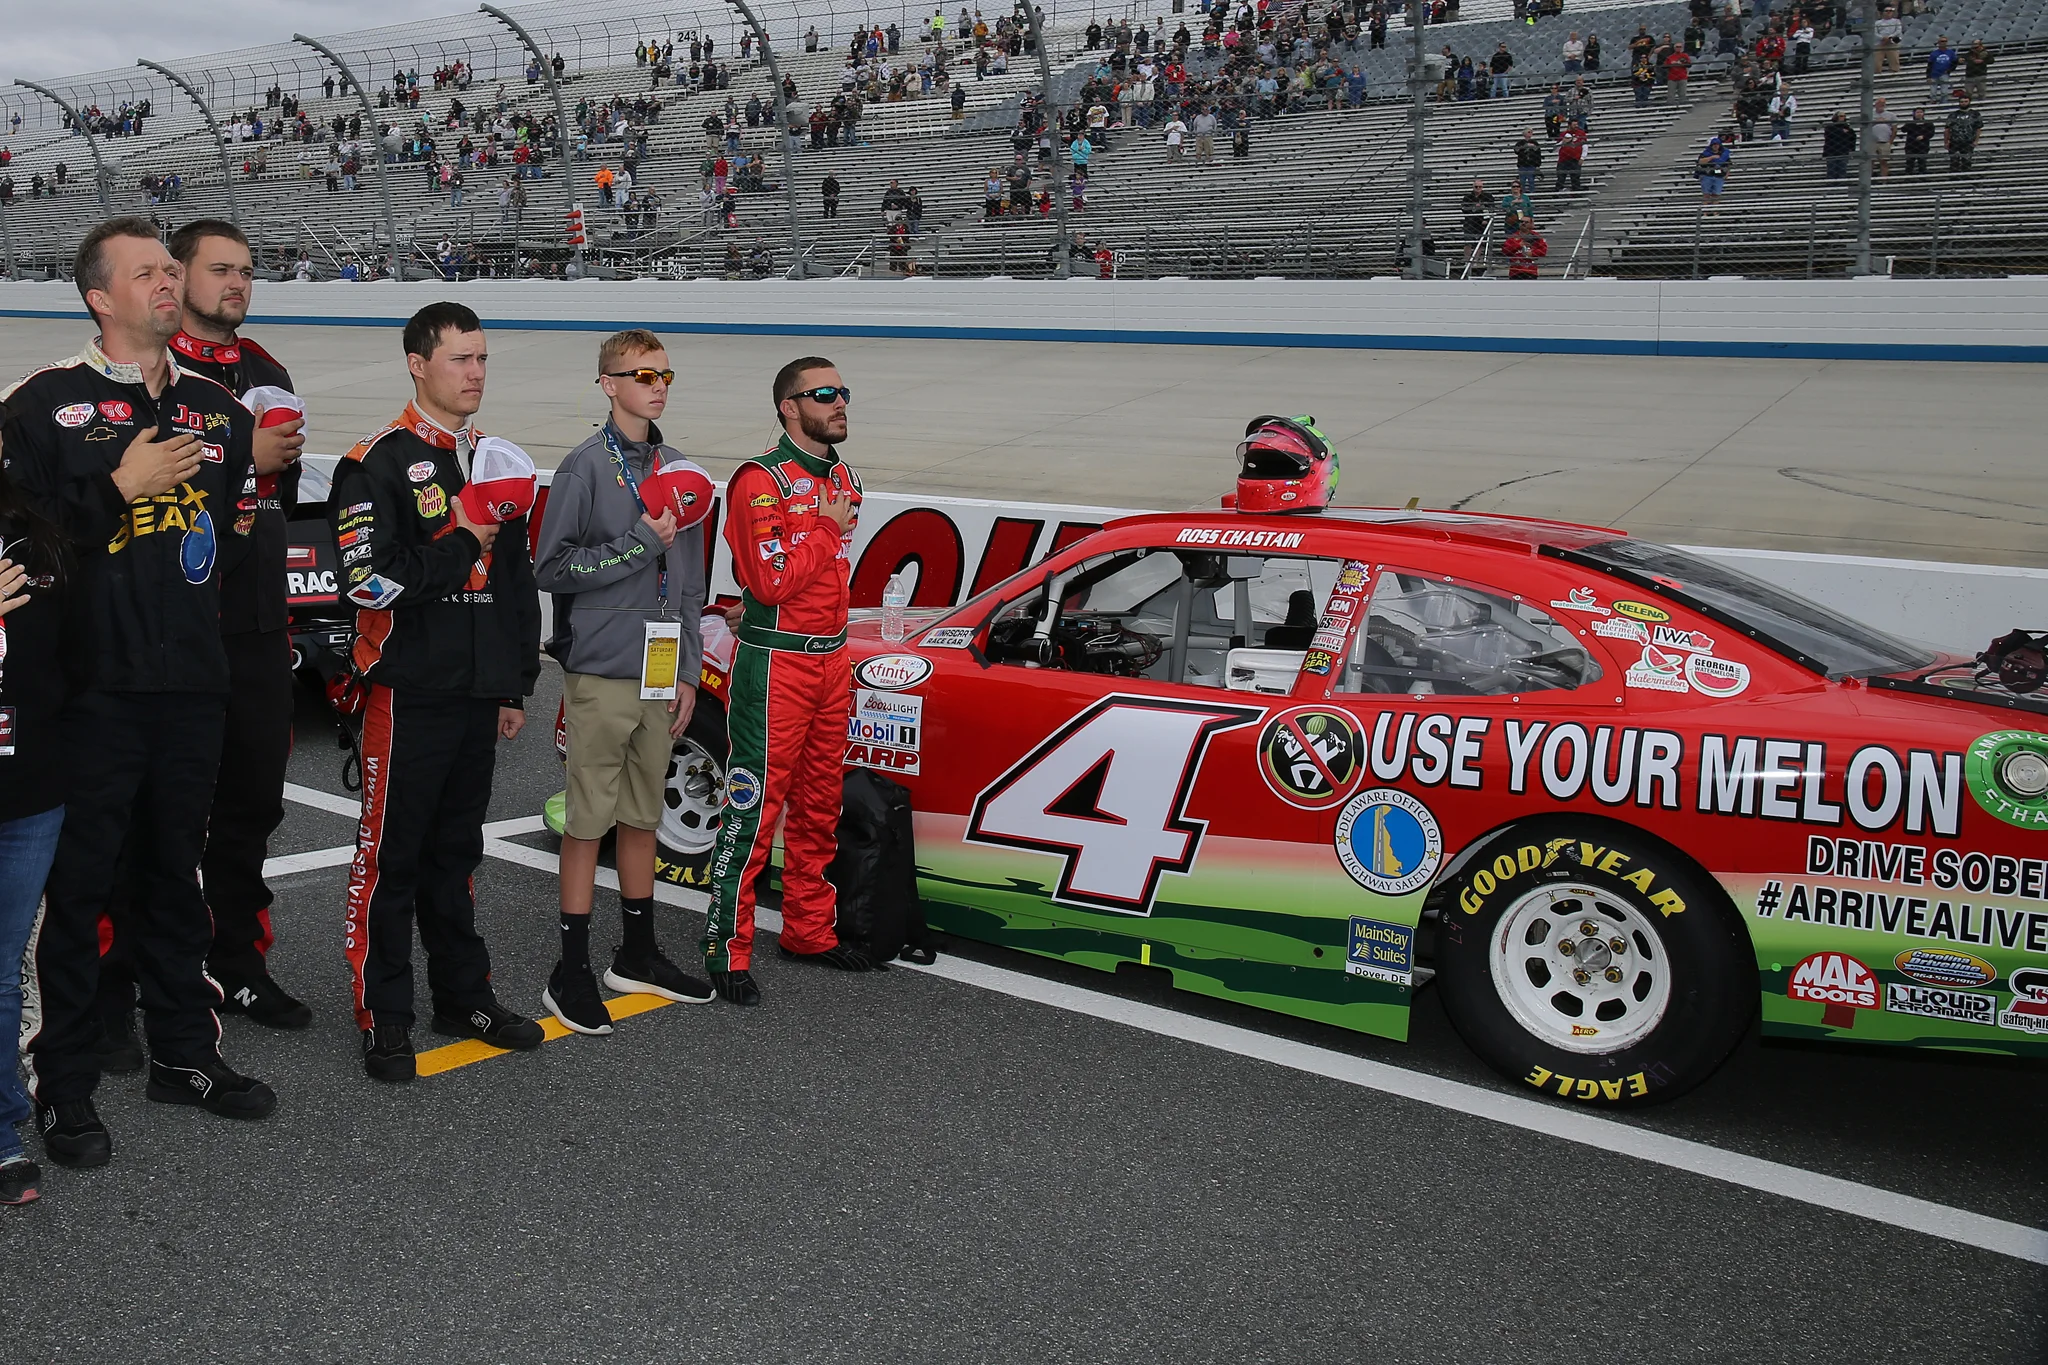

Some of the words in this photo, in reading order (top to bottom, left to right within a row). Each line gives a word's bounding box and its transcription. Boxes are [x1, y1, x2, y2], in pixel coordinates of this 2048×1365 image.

[678, 31, 697, 42] 243
[669, 265, 686, 276] 245
[58, 411, 89, 424] xfinity
[420, 486, 440, 502] Sun
[751, 497, 779, 506] SUNOCO
[347, 502, 373, 516] NASCAR
[420, 500, 443, 515] Drop
[790, 531, 811, 545] US
[1176, 528, 1222, 545] ROSS
[1219, 530, 1306, 548] CHASTAIN
[570, 563, 598, 574] Huk
[599, 543, 645, 569] Fishing
[1329, 599, 1351, 614] SEM
[1551, 600, 1610, 616] watermelon.org
[1617, 603, 1665, 620] HELENA
[939, 629, 969, 637] NASCAR
[1592, 622, 1647, 637] Watermelon
[1608, 619, 1633, 630] Florida
[926, 637, 945, 645] RACE
[946, 638, 963, 646] CAR
[1597, 630, 1639, 640] Association
[1654, 626, 1693, 647] IWA
[1302, 659, 1328, 671] SEAL
[1305, 651, 1332, 662] FLEX
[866, 662, 915, 683] xfinity
[1694, 657, 1736, 674] GEORGIA
[1694, 665, 1735, 679] WATERMELON
[878, 678, 898, 686] SERIES
[1628, 671, 1688, 688] Watermelon
[863, 695, 892, 712] Coors
[893, 703, 919, 715] LIGHT
[847, 718, 895, 742] Mobil
[903, 727, 911, 744] 1
[1973, 731, 2048, 761] AMERIC
[847, 744, 920, 770] ARP
[1369, 710, 1492, 790] USE
[1504, 719, 1683, 808] YOUR
[1697, 733, 1966, 837] MELON
[967, 696, 1258, 913] 4
[1985, 787, 2048, 824] ETHA
[1338, 791, 1389, 832] DELAWARE
[1392, 792, 1434, 828] OFFICE
[1427, 827, 1440, 846] OF
[723, 814, 743, 845] DRIVE
[1341, 851, 1393, 892] HIGHWAY
[1394, 863, 1432, 892] SAFETY
[1807, 835, 1926, 886] DRIVE
[1932, 848, 2048, 900] SOBE
[1354, 922, 1410, 951] MainStay
[1373, 945, 1407, 965] Suites
[1911, 950, 1972, 965] Carolina
[1908, 957, 1982, 973] Driveline
[1391, 973, 1407, 985] DE
[1793, 955, 1876, 994] MAC
[1792, 984, 1876, 1007] TOOLS
[1889, 999, 1992, 1023] PERFORMANCE
[1573, 1027, 1596, 1037] AERO
[1524, 1064, 1649, 1100] EAGLE
